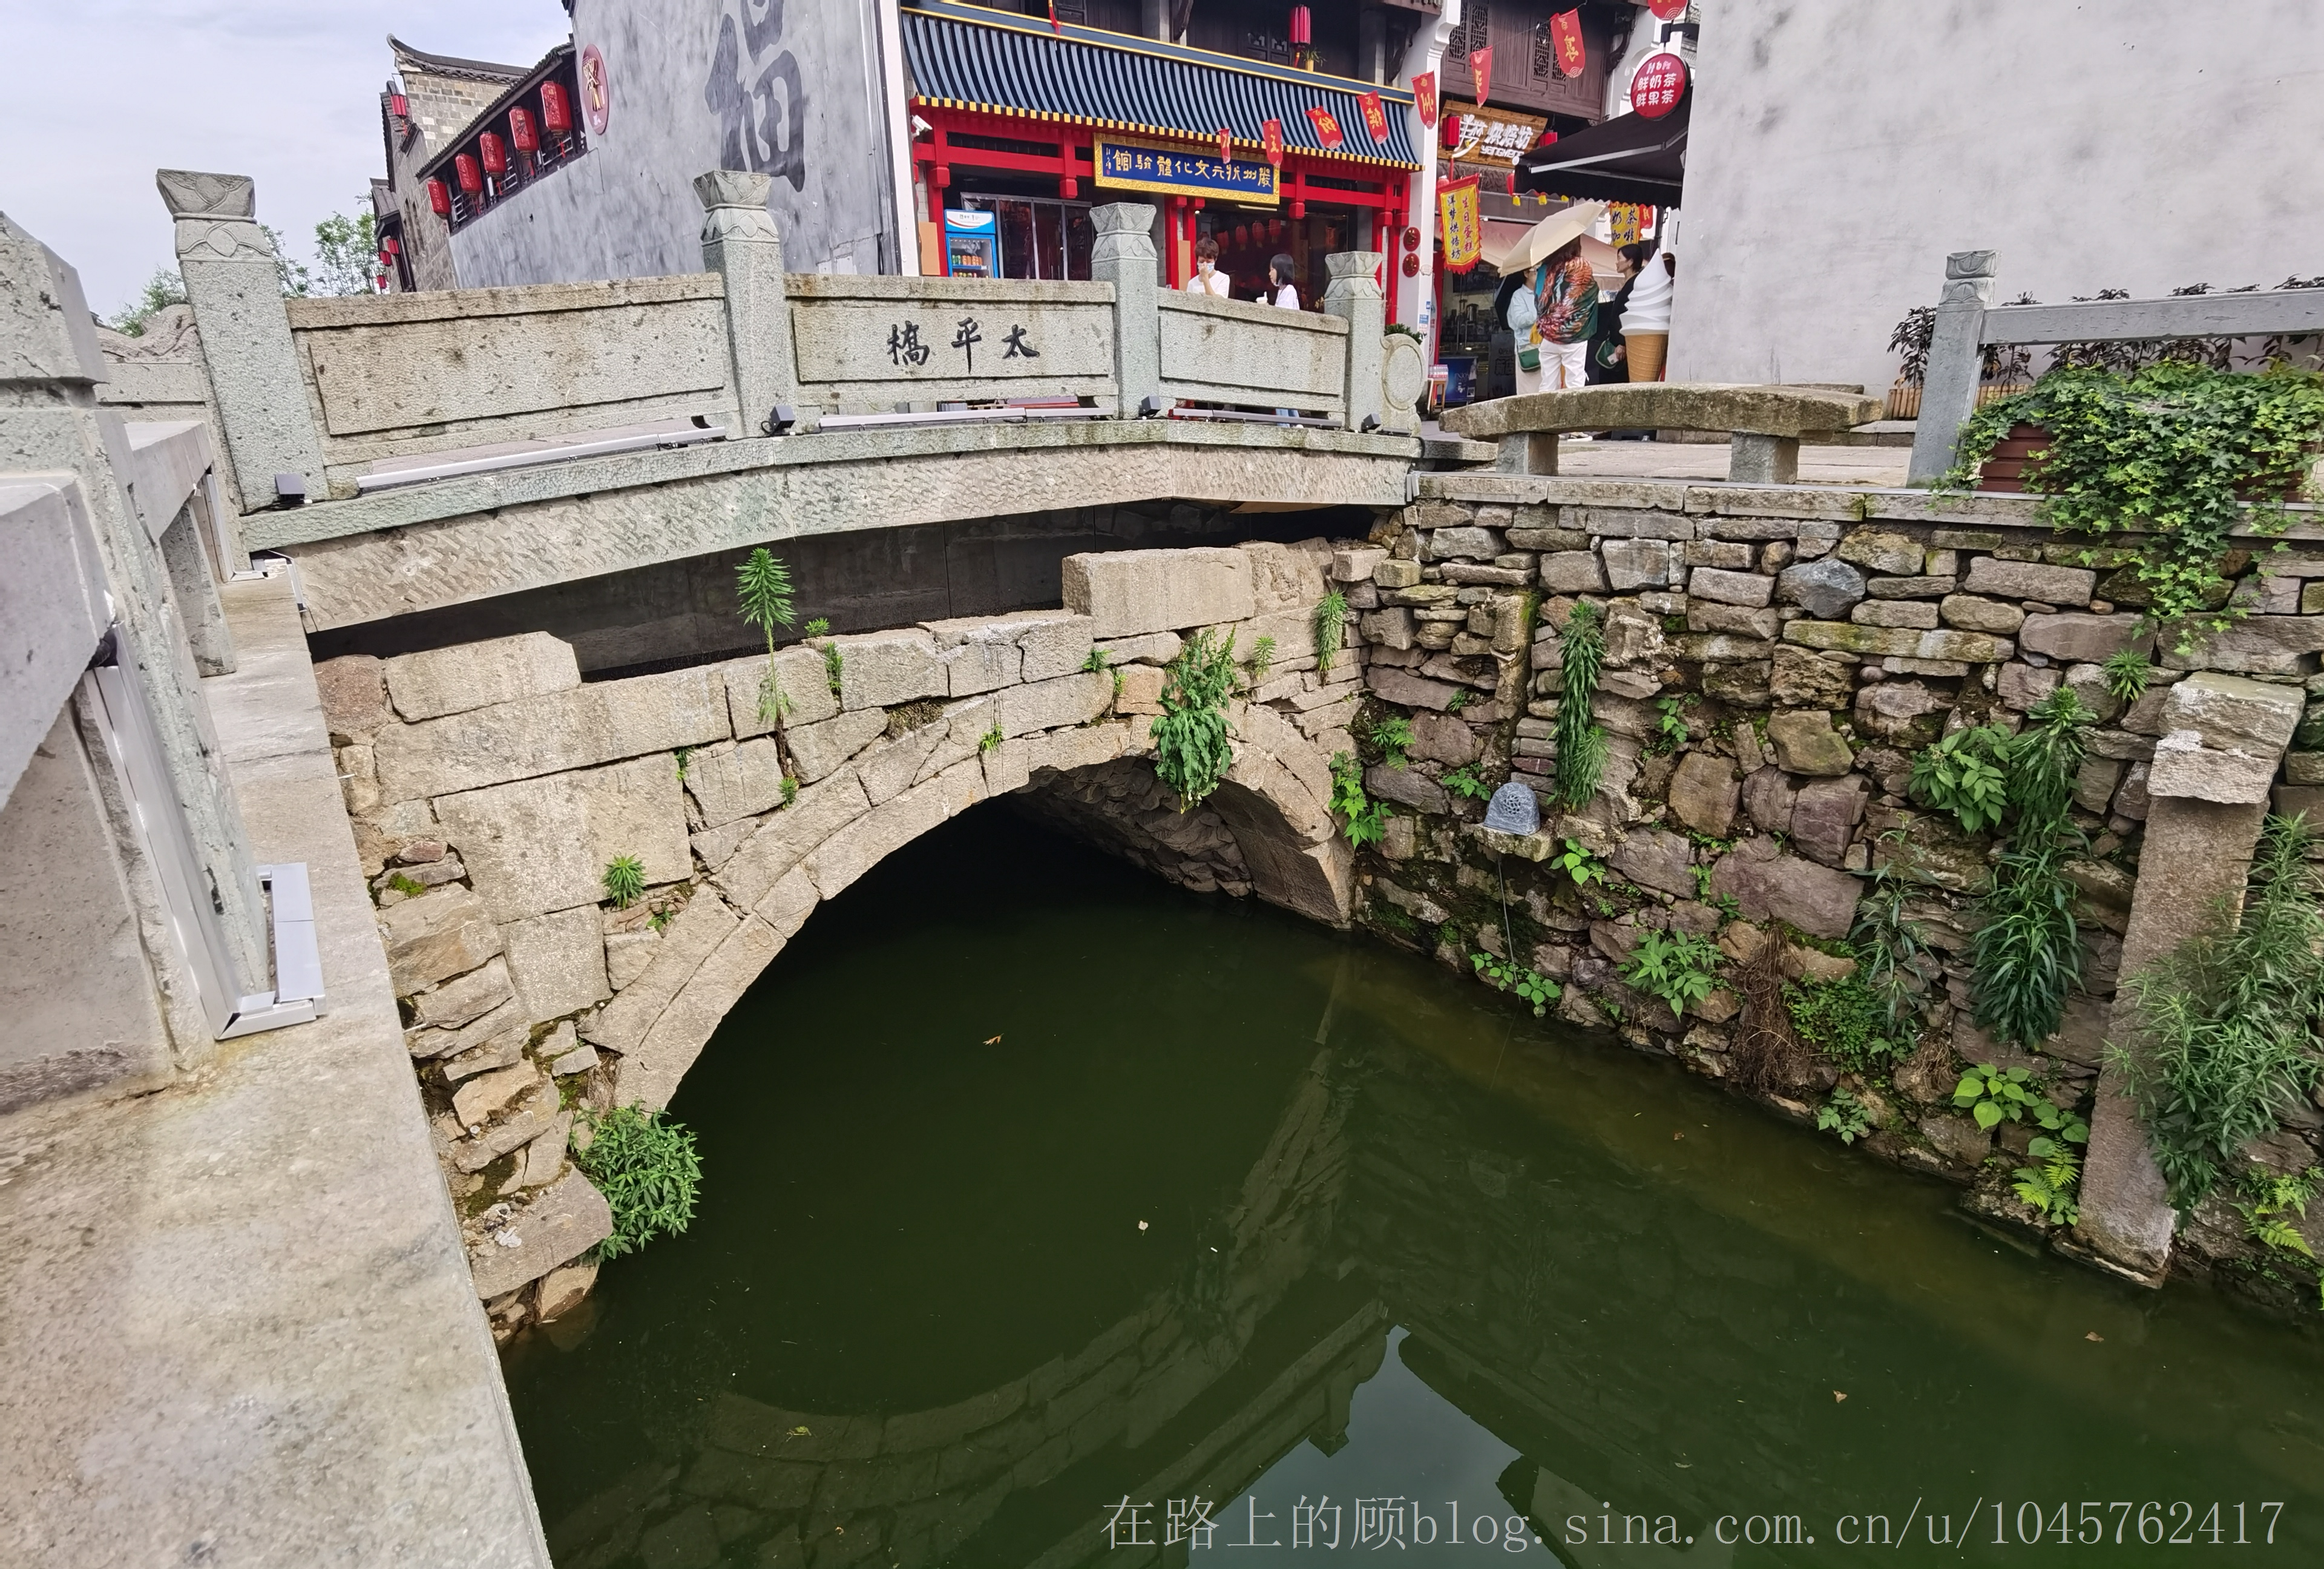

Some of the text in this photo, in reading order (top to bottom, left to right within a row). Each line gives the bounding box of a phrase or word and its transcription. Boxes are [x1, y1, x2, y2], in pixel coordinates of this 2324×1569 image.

[1636, 90, 1674, 107] 鲜果茶
[1638, 73, 1676, 91] 鲜奶茶
[1447, 194, 1462, 260] 洋梦烘焙坊
[1462, 197, 1475, 253] 生日蛋糕
[1611, 208, 1638, 226] 奶茶
[887, 317, 1040, 374] 太平橋
